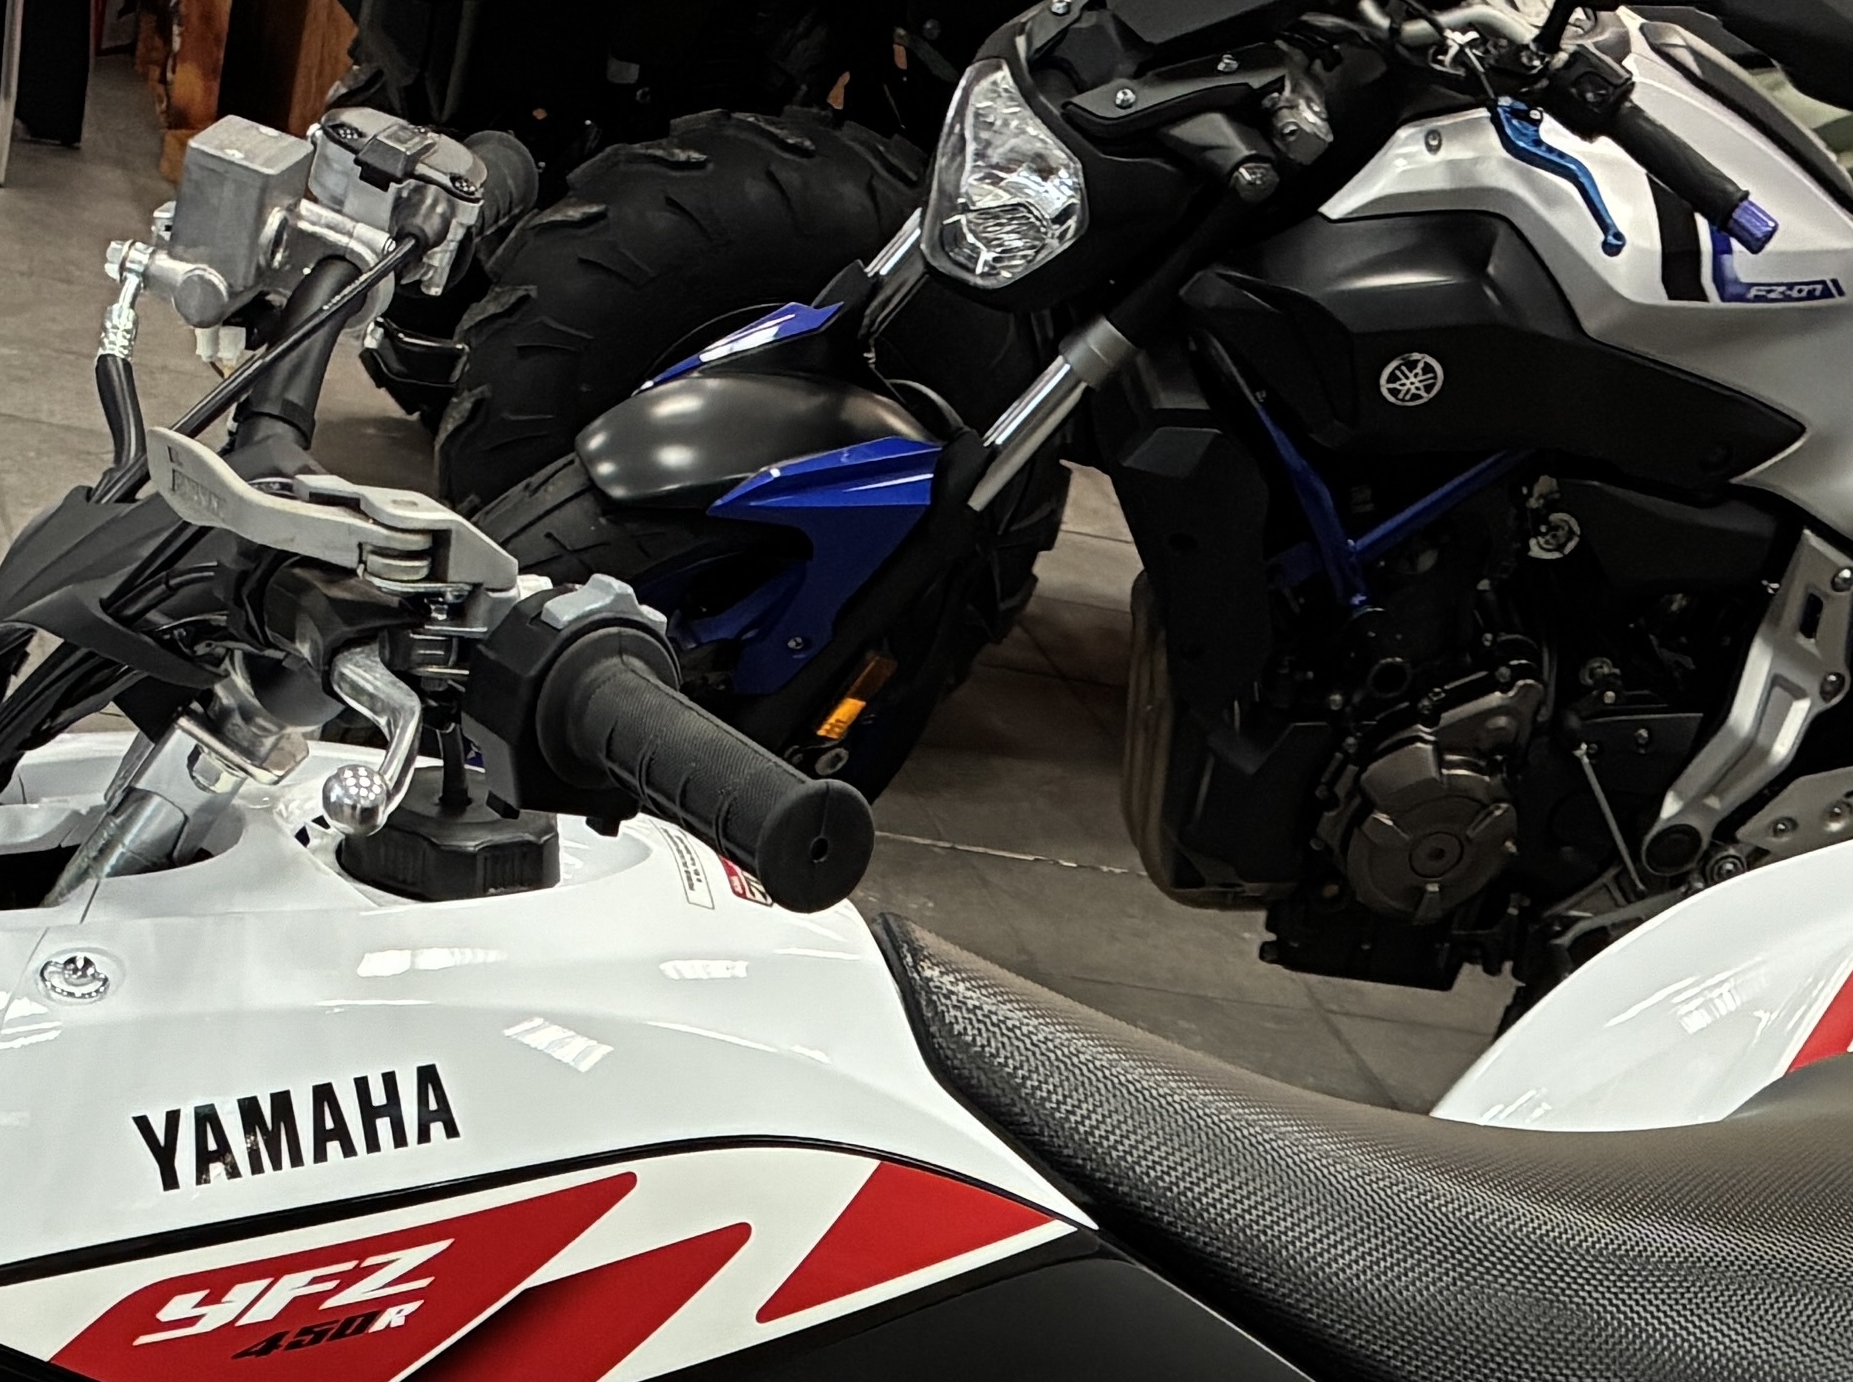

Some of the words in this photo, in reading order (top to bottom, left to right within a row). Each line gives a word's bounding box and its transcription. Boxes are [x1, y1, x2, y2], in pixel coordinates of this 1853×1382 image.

[1747, 284, 1823, 300] FZ-07
[132, 1063, 461, 1192] YAMAHA
[133, 1238, 455, 1346] YFZ
[231, 1299, 425, 1360] 450R
